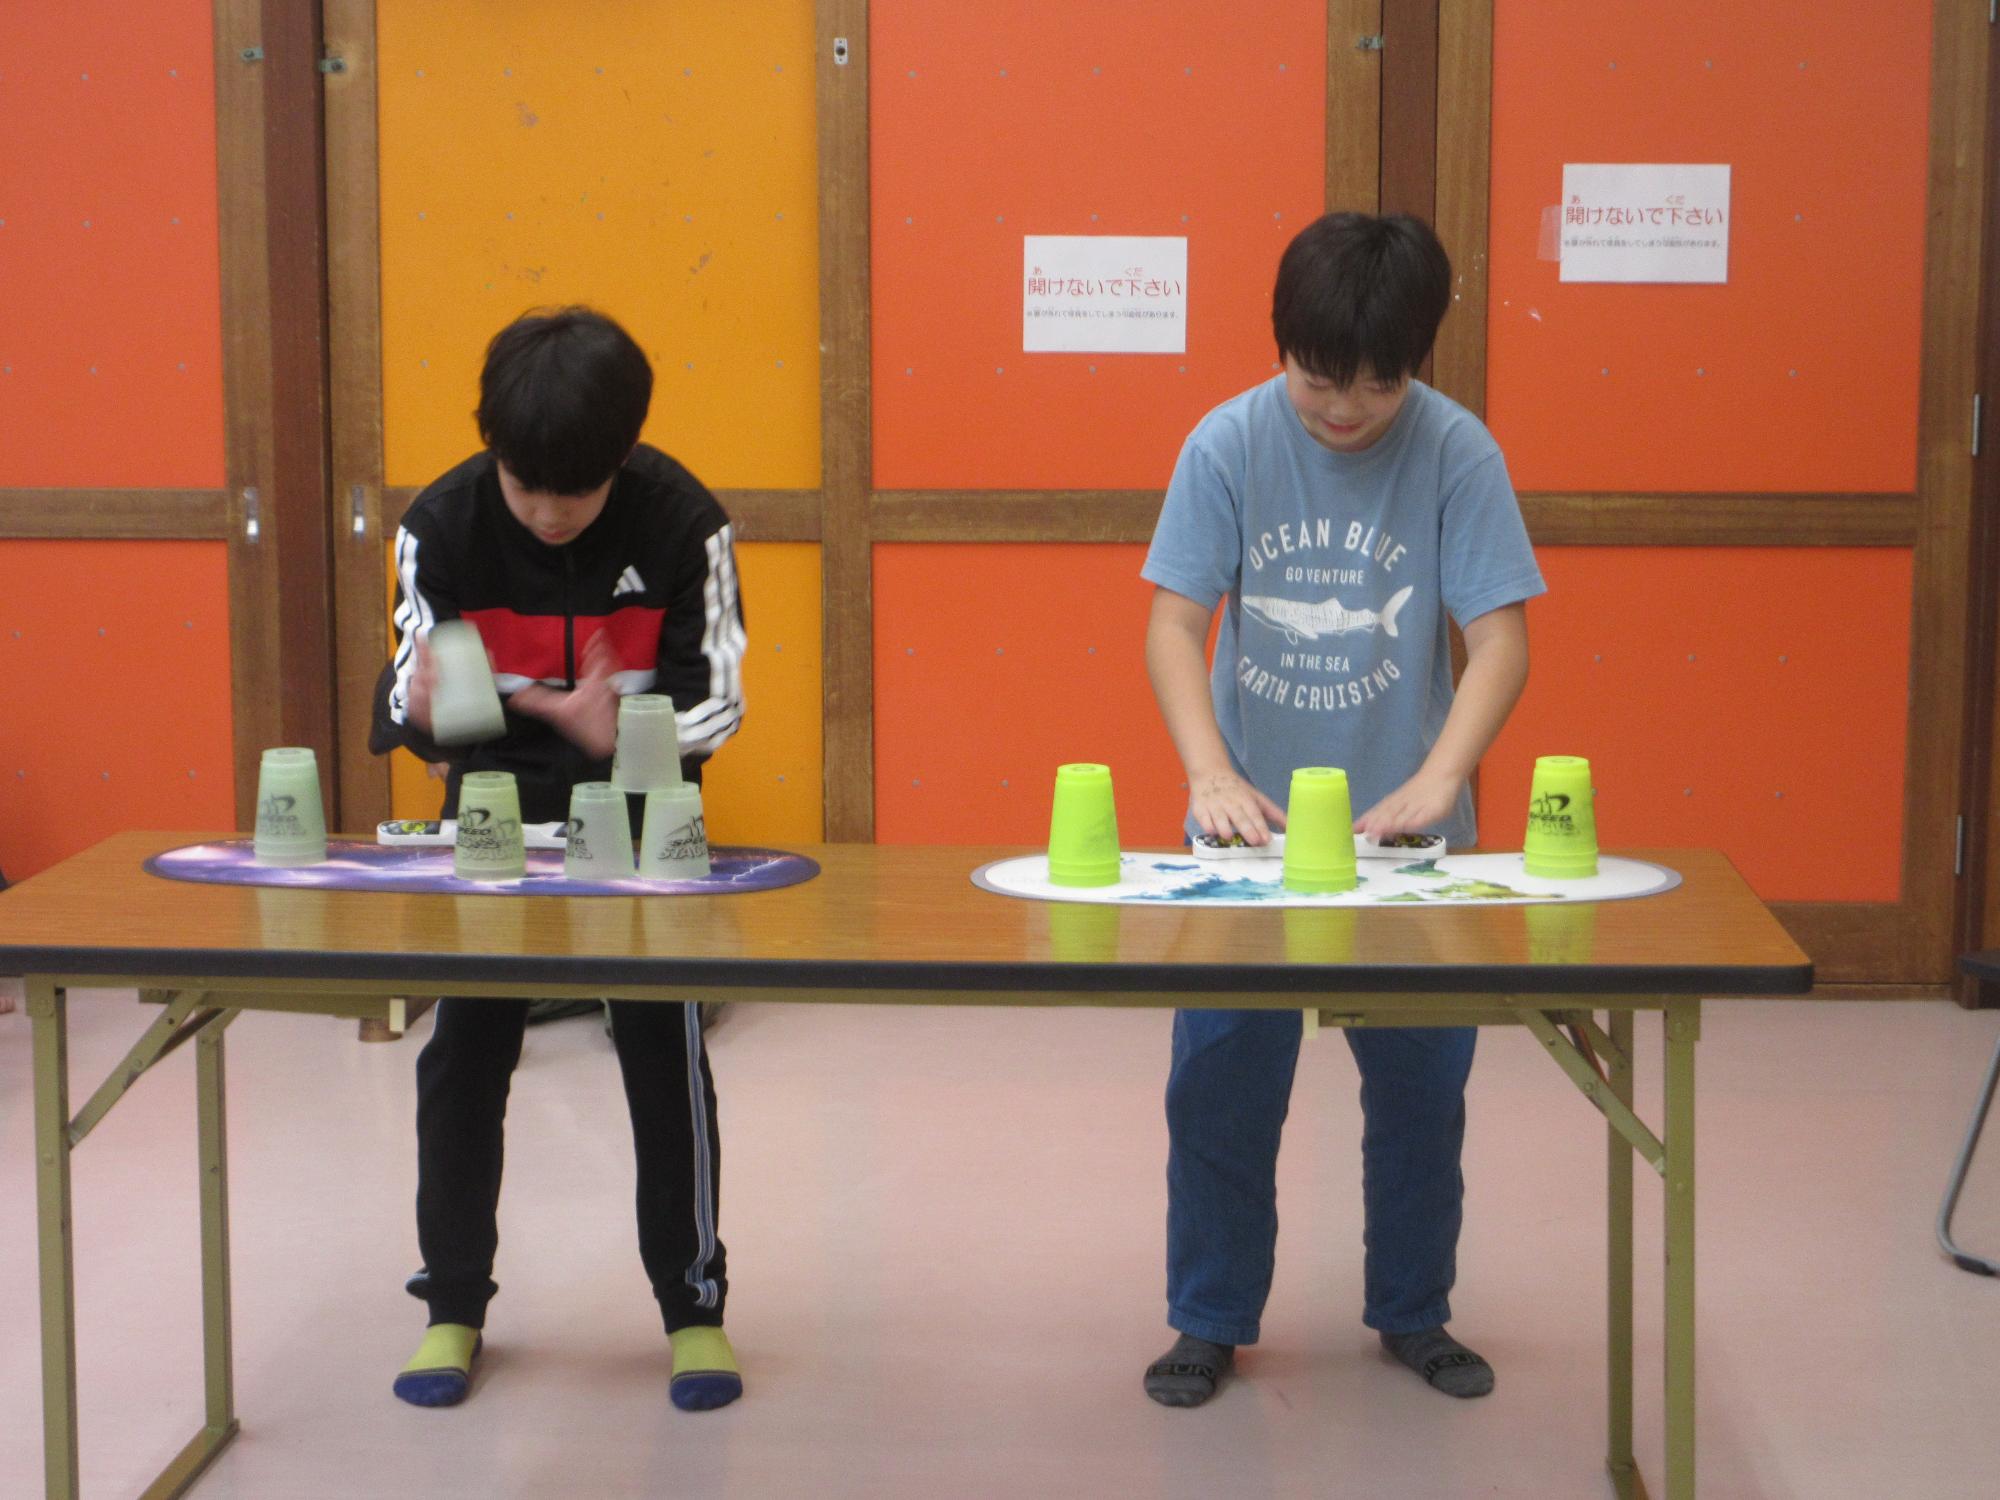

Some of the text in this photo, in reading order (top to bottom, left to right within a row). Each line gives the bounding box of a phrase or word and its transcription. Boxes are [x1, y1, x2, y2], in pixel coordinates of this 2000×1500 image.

[1566, 206, 1723, 225] 開けないで下さい
[1028, 277, 1182, 297] 開けないで下さい
[1248, 518, 1407, 572] OCEAN BLUE
[1285, 566, 1365, 585] GO VENTURE
[1280, 652, 1350, 672] IN THE SEA
[1238, 655, 1401, 711] EARTH CRUISING
